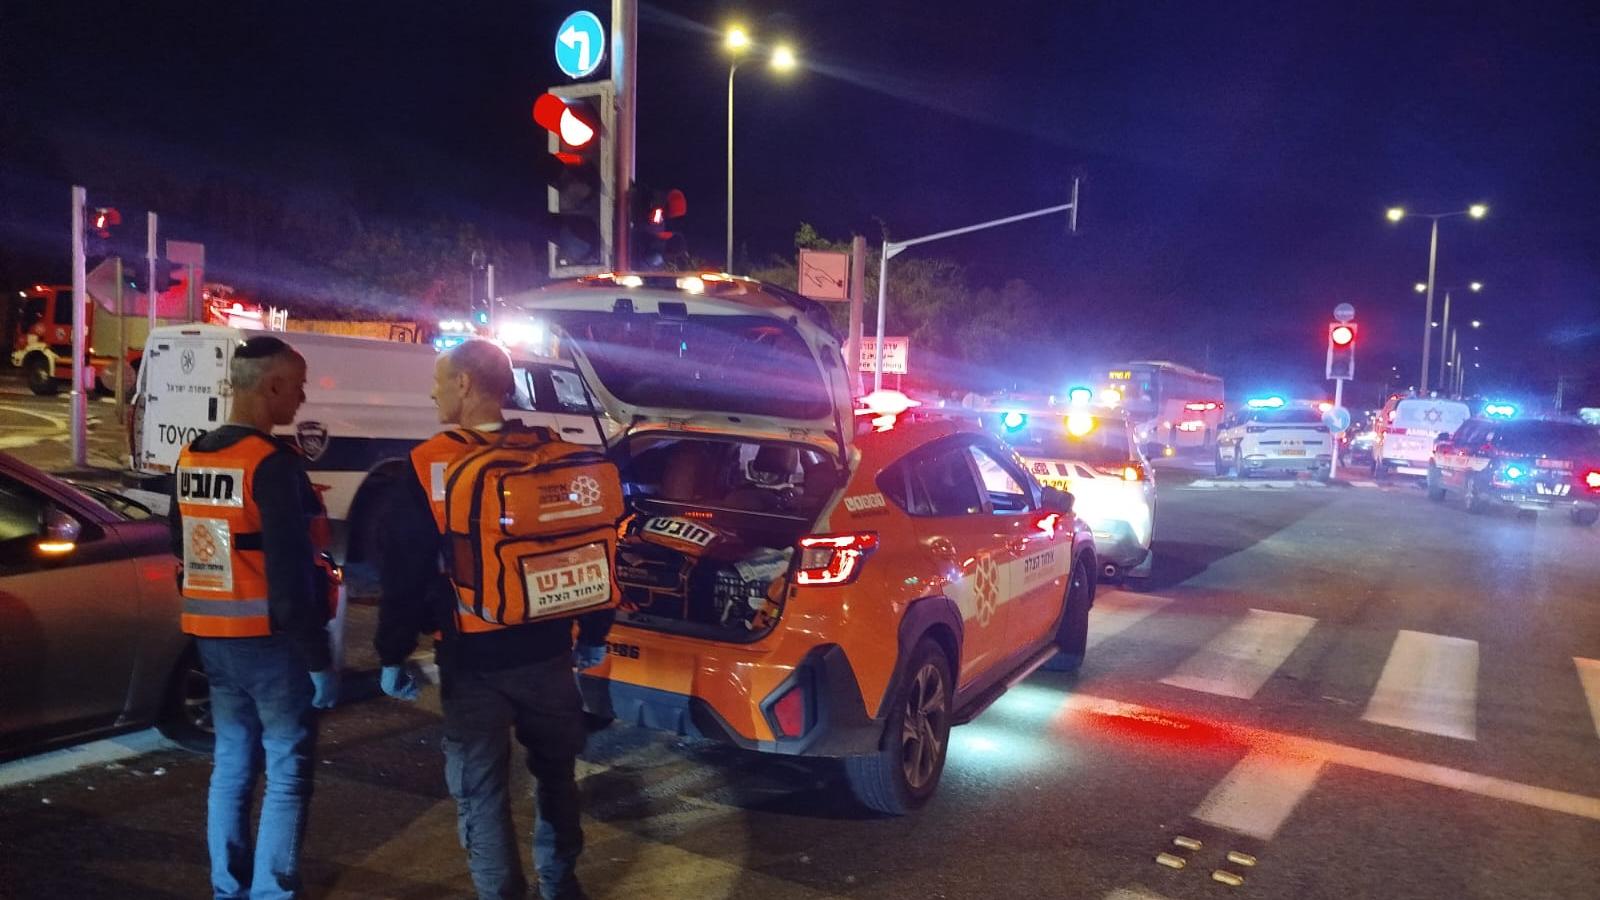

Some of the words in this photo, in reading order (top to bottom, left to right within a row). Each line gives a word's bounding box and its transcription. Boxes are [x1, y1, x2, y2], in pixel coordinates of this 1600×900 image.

[158, 424, 208, 445] TOYO
[180, 472, 234, 500] חובש
[650, 518, 710, 543] חובש
[535, 562, 603, 593] חובש
[538, 591, 571, 607] הצלה
[573, 582, 606, 597] איחוד
